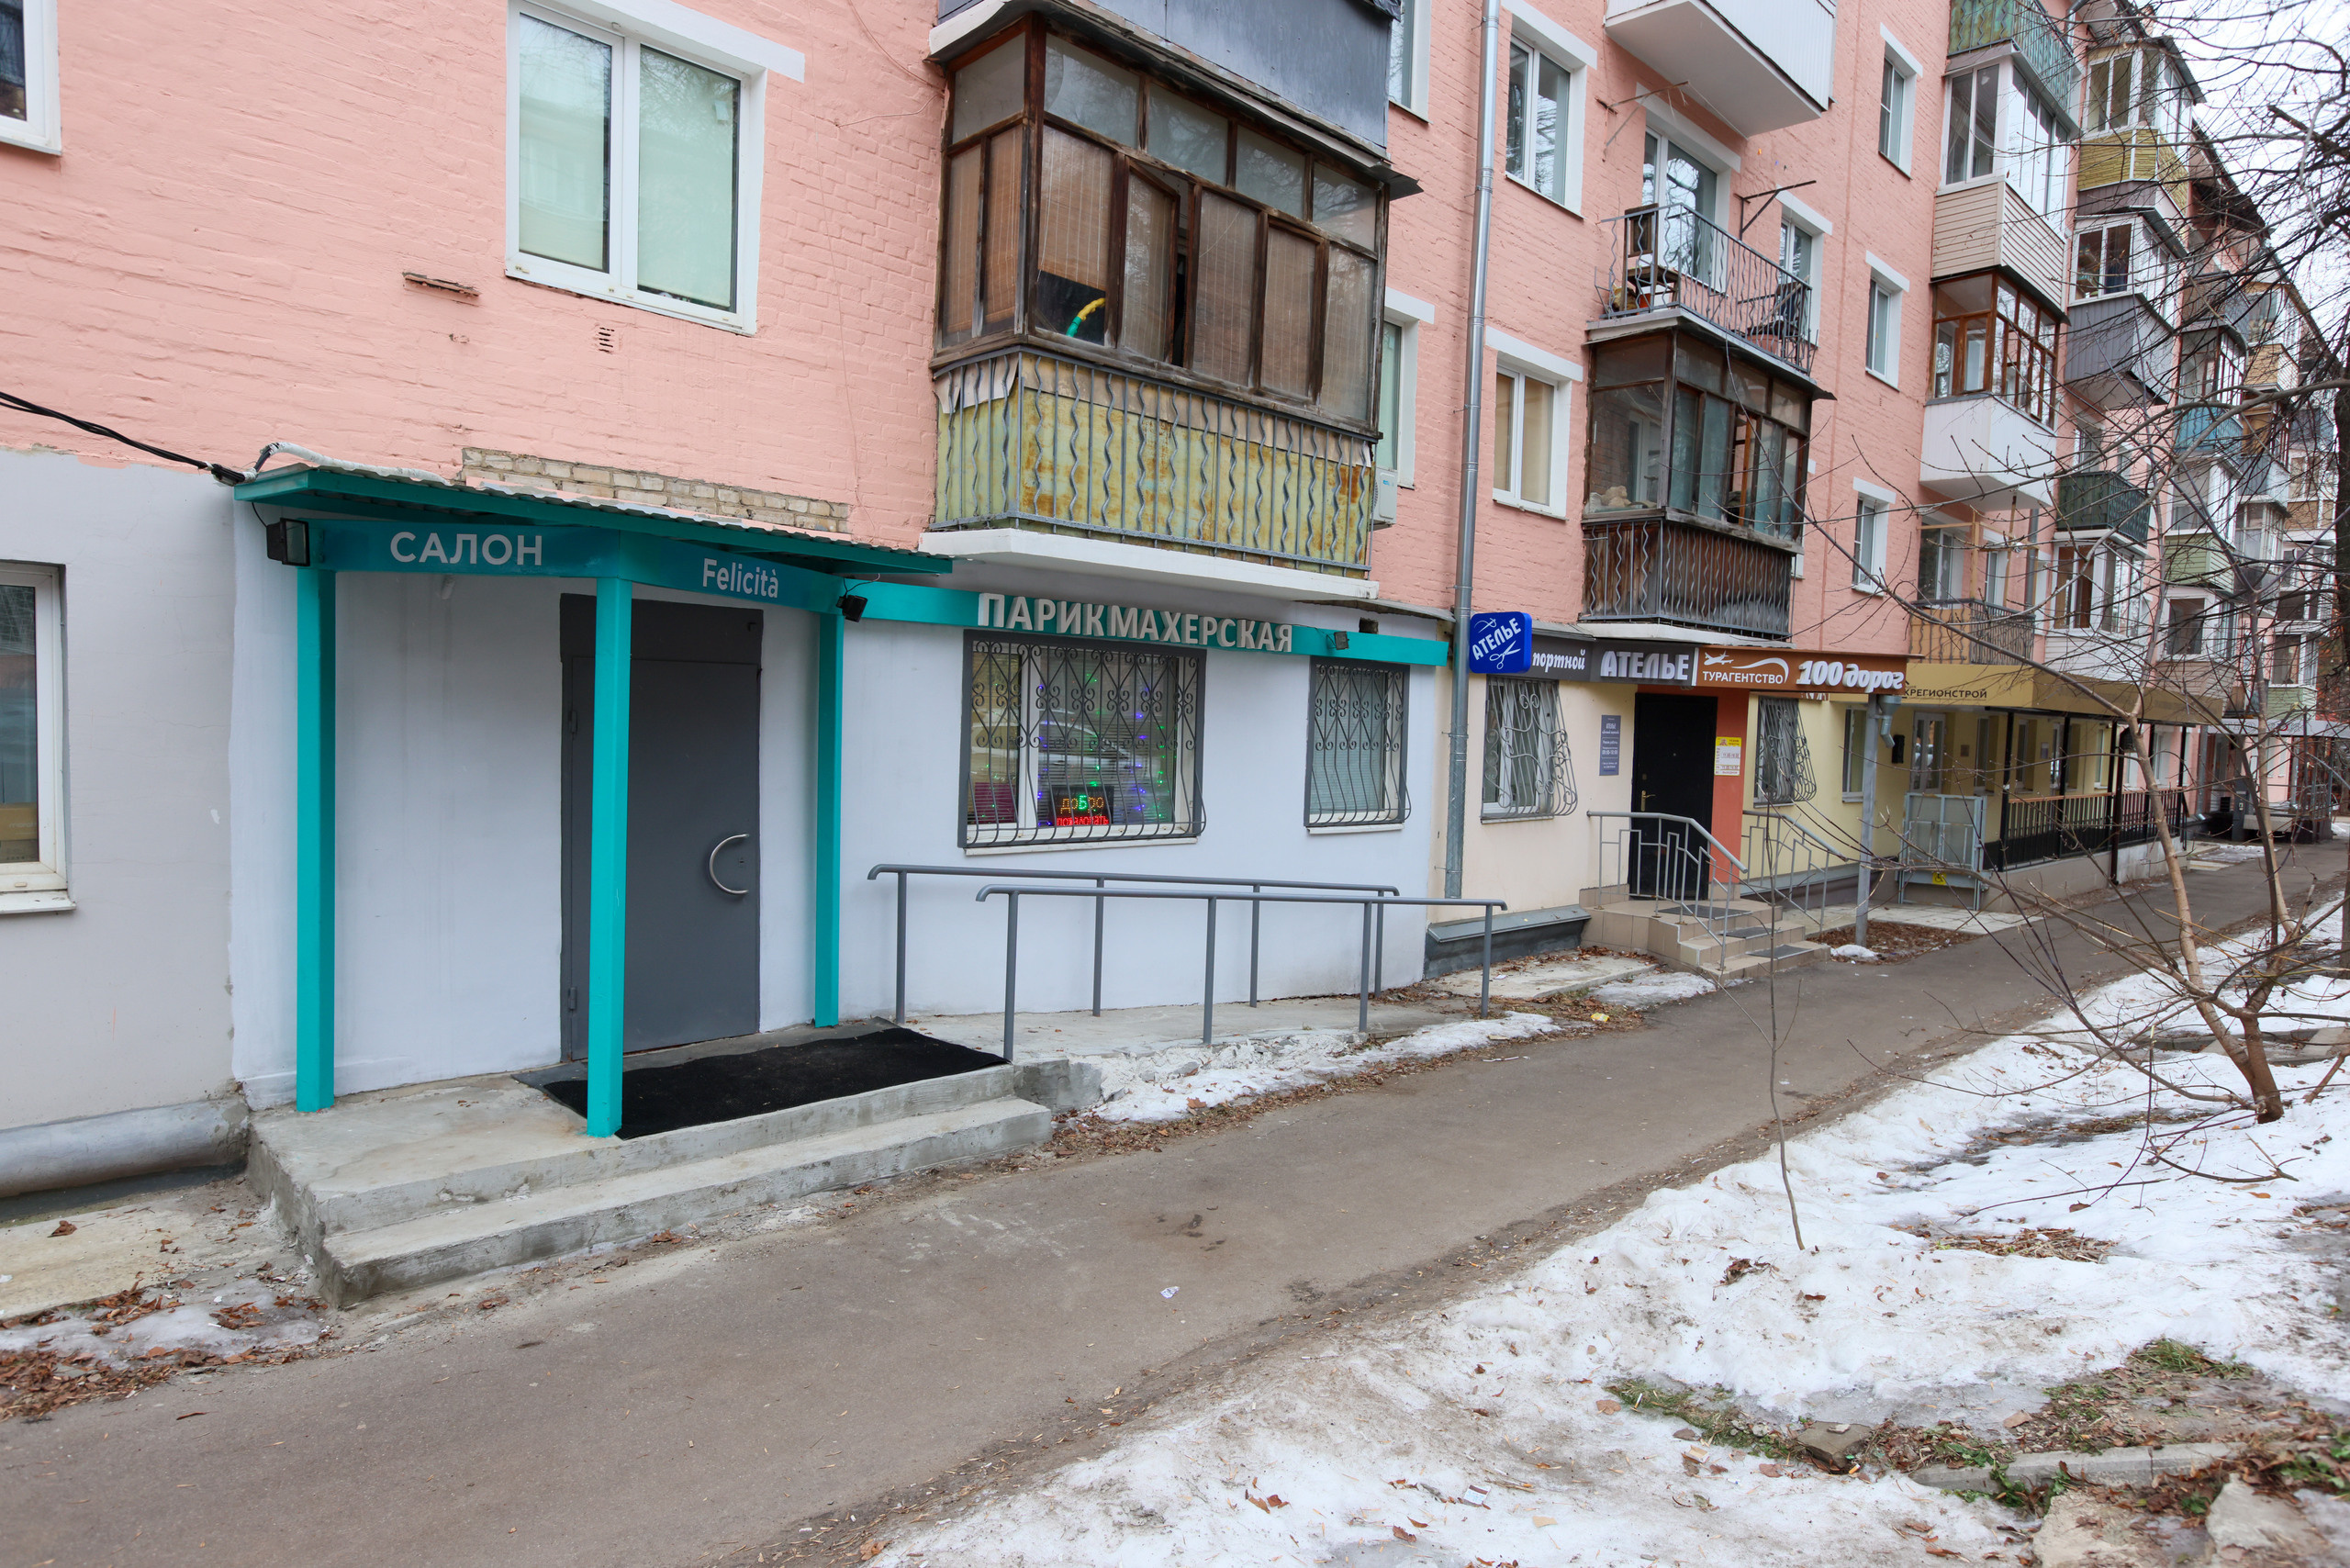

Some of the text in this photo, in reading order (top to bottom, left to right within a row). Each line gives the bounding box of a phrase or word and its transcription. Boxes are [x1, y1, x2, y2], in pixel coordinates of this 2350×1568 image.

[390, 531, 543, 566] САЛОН
[702, 557, 779, 599] Felicità
[978, 592, 1292, 653] ПАРИКМАХЕРСКАЯ
[1472, 617, 1522, 661] АТЕЛЬЕ
[1532, 648, 1585, 673] портной
[1600, 650, 1689, 680] АТЕЛЬЕ
[1703, 670, 1784, 684] ТУРАГЕНТСТВО
[1796, 660, 1904, 694] 100 дорог
